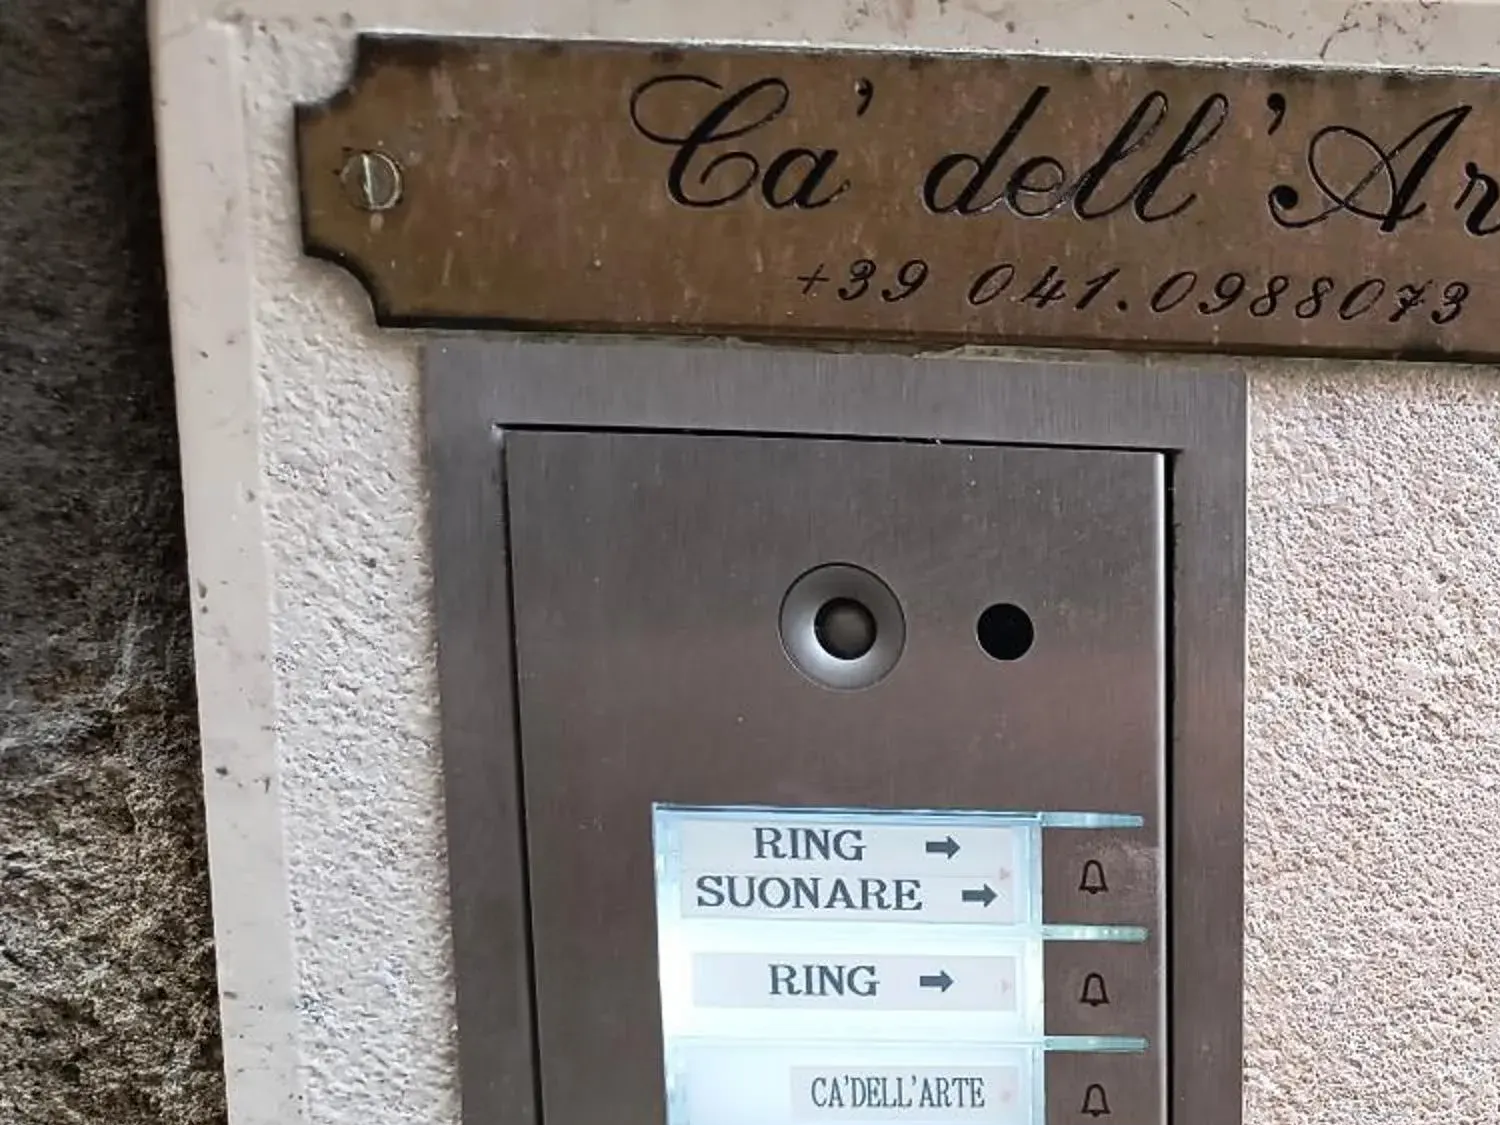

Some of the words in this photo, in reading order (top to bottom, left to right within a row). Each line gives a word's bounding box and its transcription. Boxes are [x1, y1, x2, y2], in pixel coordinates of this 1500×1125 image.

[629, 74, 875, 212] Ca'
[796, 257, 932, 305] +39
[965, 260, 1473, 326] 041.0988073
[754, 827, 867, 861] RING
[696, 876, 923, 911] SUONARE
[768, 964, 880, 996] RING
[811, 1076, 986, 1109] CA'DELL'ARTE
